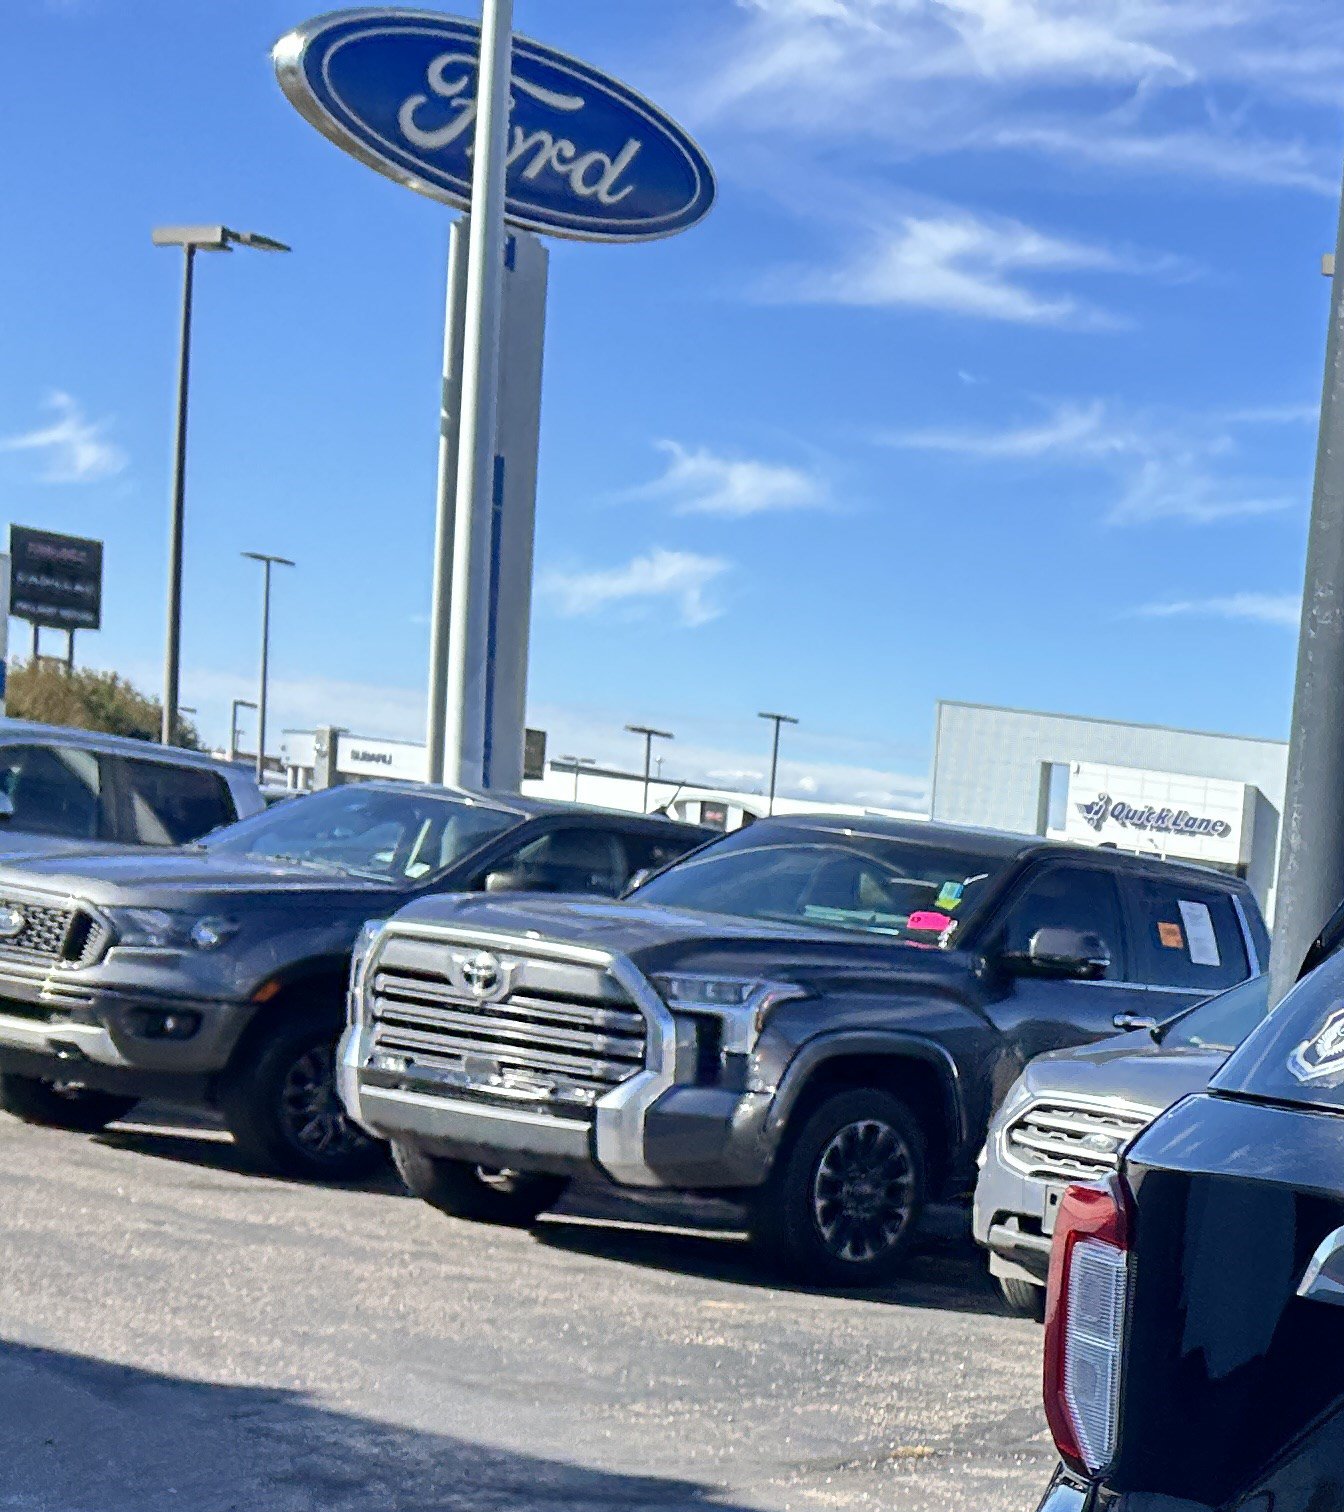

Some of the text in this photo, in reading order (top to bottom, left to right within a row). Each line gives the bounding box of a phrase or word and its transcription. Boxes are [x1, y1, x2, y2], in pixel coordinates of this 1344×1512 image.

[397, 52, 642, 205] Frd
[1110, 801, 1226, 835] Quick Lane
